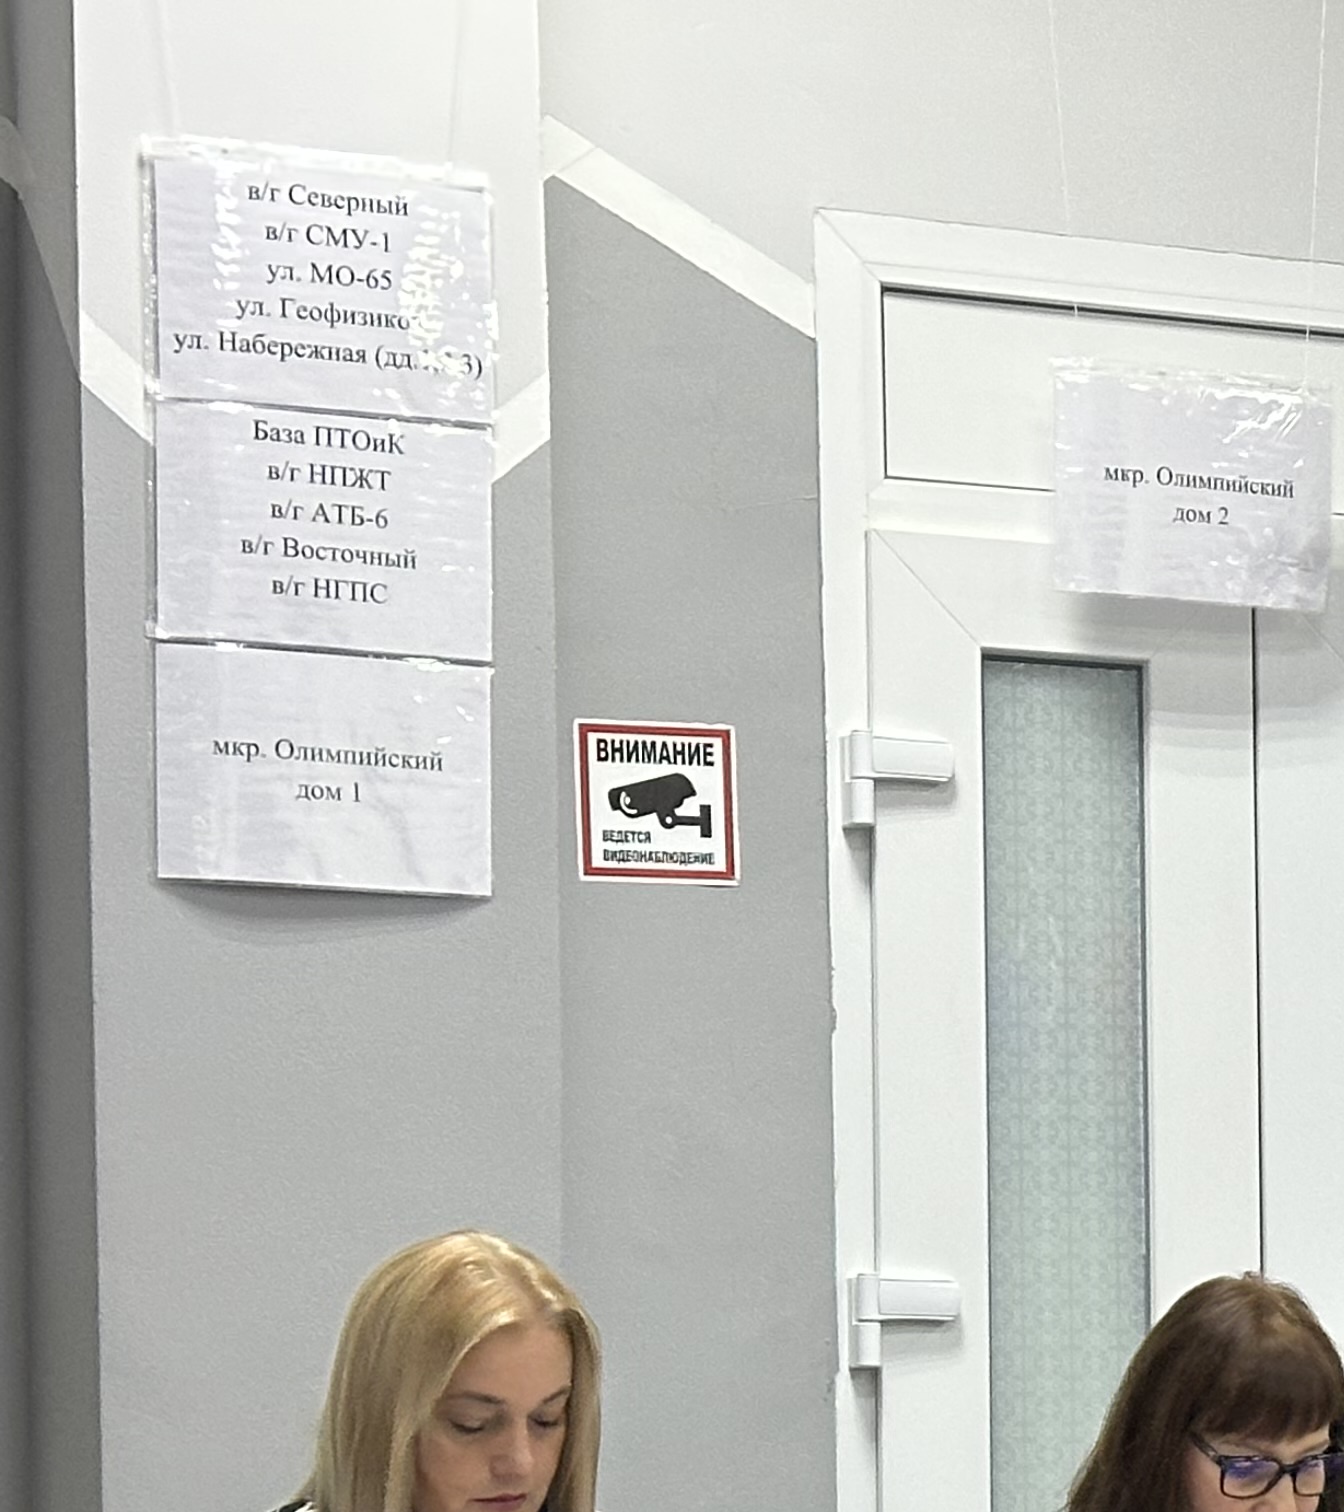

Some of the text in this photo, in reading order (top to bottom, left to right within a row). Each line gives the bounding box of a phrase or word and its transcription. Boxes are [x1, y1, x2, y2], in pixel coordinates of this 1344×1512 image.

[247, 181, 409, 217] в/г Северный
[265, 222, 390, 253] в/г СМУ-1
[266, 262, 393, 290] ул. МО-65
[235, 297, 419, 332] ул. Геофизико
[173, 332, 209, 354] ул.
[218, 331, 367, 364] Набережная
[253, 419, 404, 455] База ПТОиК
[267, 461, 392, 491] в/г НПЖТ
[1104, 466, 1294, 499] мкр. Олимпийский
[270, 499, 389, 529] в/г АТБ-6
[1173, 506, 1229, 525] дом 2
[240, 534, 417, 570] в/г Восточный
[271, 575, 388, 604] в/г НГПС
[212, 738, 443, 771] мкр. Олимпийский
[596, 738, 714, 767] ВНИМАНИЕ
[296, 782, 361, 802] дом 1
[602, 830, 651, 845] ВЕДЕТСЯ
[603, 849, 715, 867] ВИДЕОНАБЛЮДЕНИЕ
